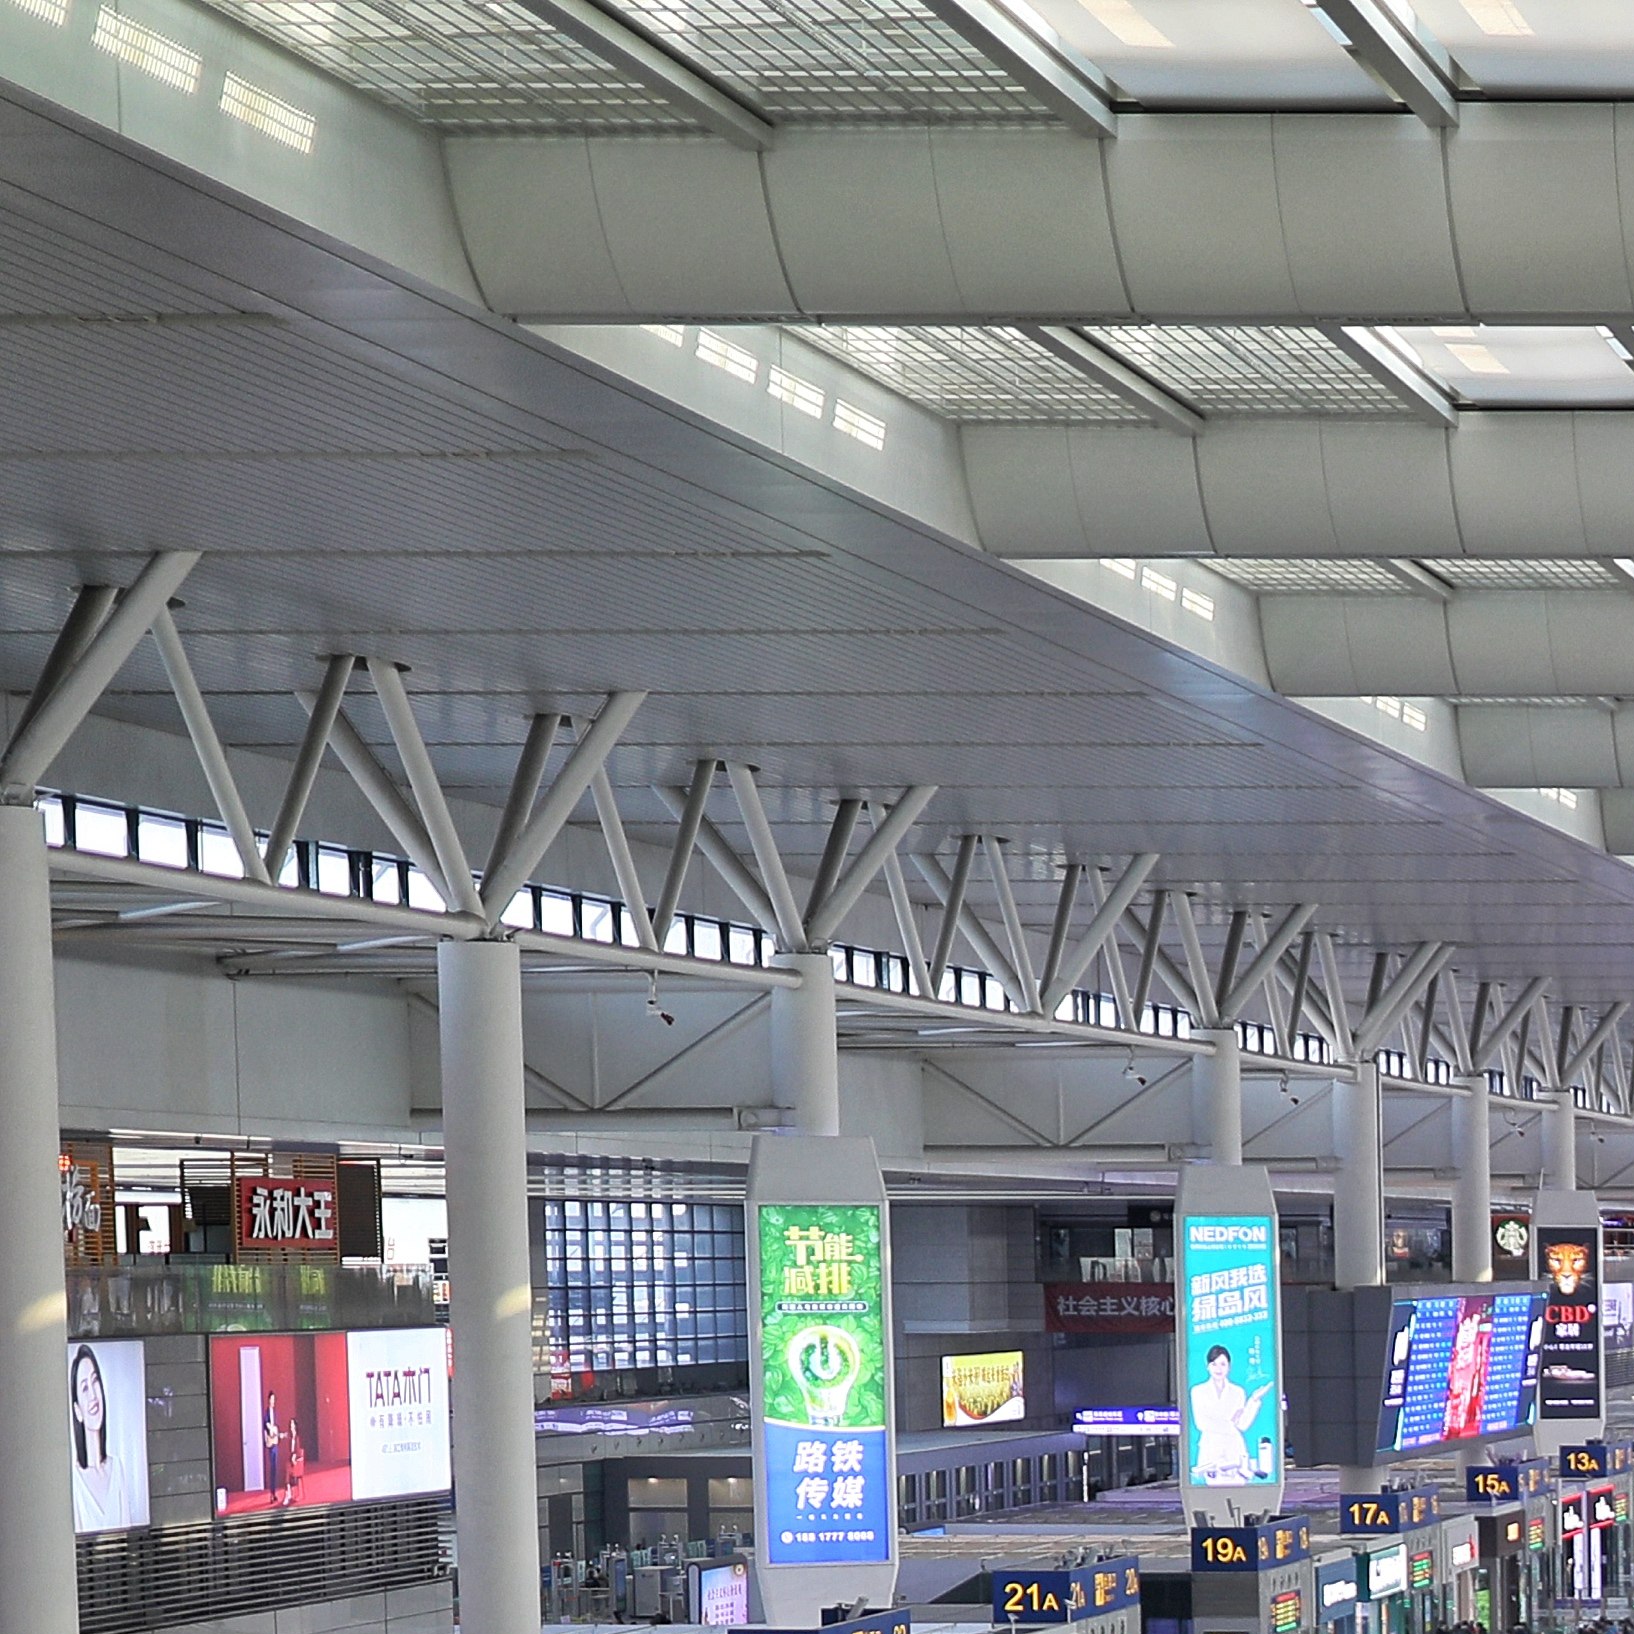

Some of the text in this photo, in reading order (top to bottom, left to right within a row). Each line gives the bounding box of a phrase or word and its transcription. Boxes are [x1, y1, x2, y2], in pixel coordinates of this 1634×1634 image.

[252, 1186, 334, 1240] 永和大王
[783, 1226, 864, 1265] 节能
[1190, 1226, 1266, 1242] NEDFON
[783, 1262, 852, 1294] 减排
[1190, 1263, 1267, 1297] 新风我选
[1057, 1296, 1174, 1317] 社会主义核心
[1191, 1284, 1268, 1323] 绿岛风
[1545, 1304, 1589, 1323] CBD
[365, 1367, 431, 1409] TATA木门
[793, 1440, 864, 1474] 路铁
[1566, 1451, 1599, 1471] 13A
[795, 1475, 866, 1510] 传媒
[1473, 1473, 1510, 1495] 15A
[1349, 1503, 1390, 1525] 17A
[1202, 1537, 1247, 1563] 19A
[1004, 1583, 1060, 1611] 21A
